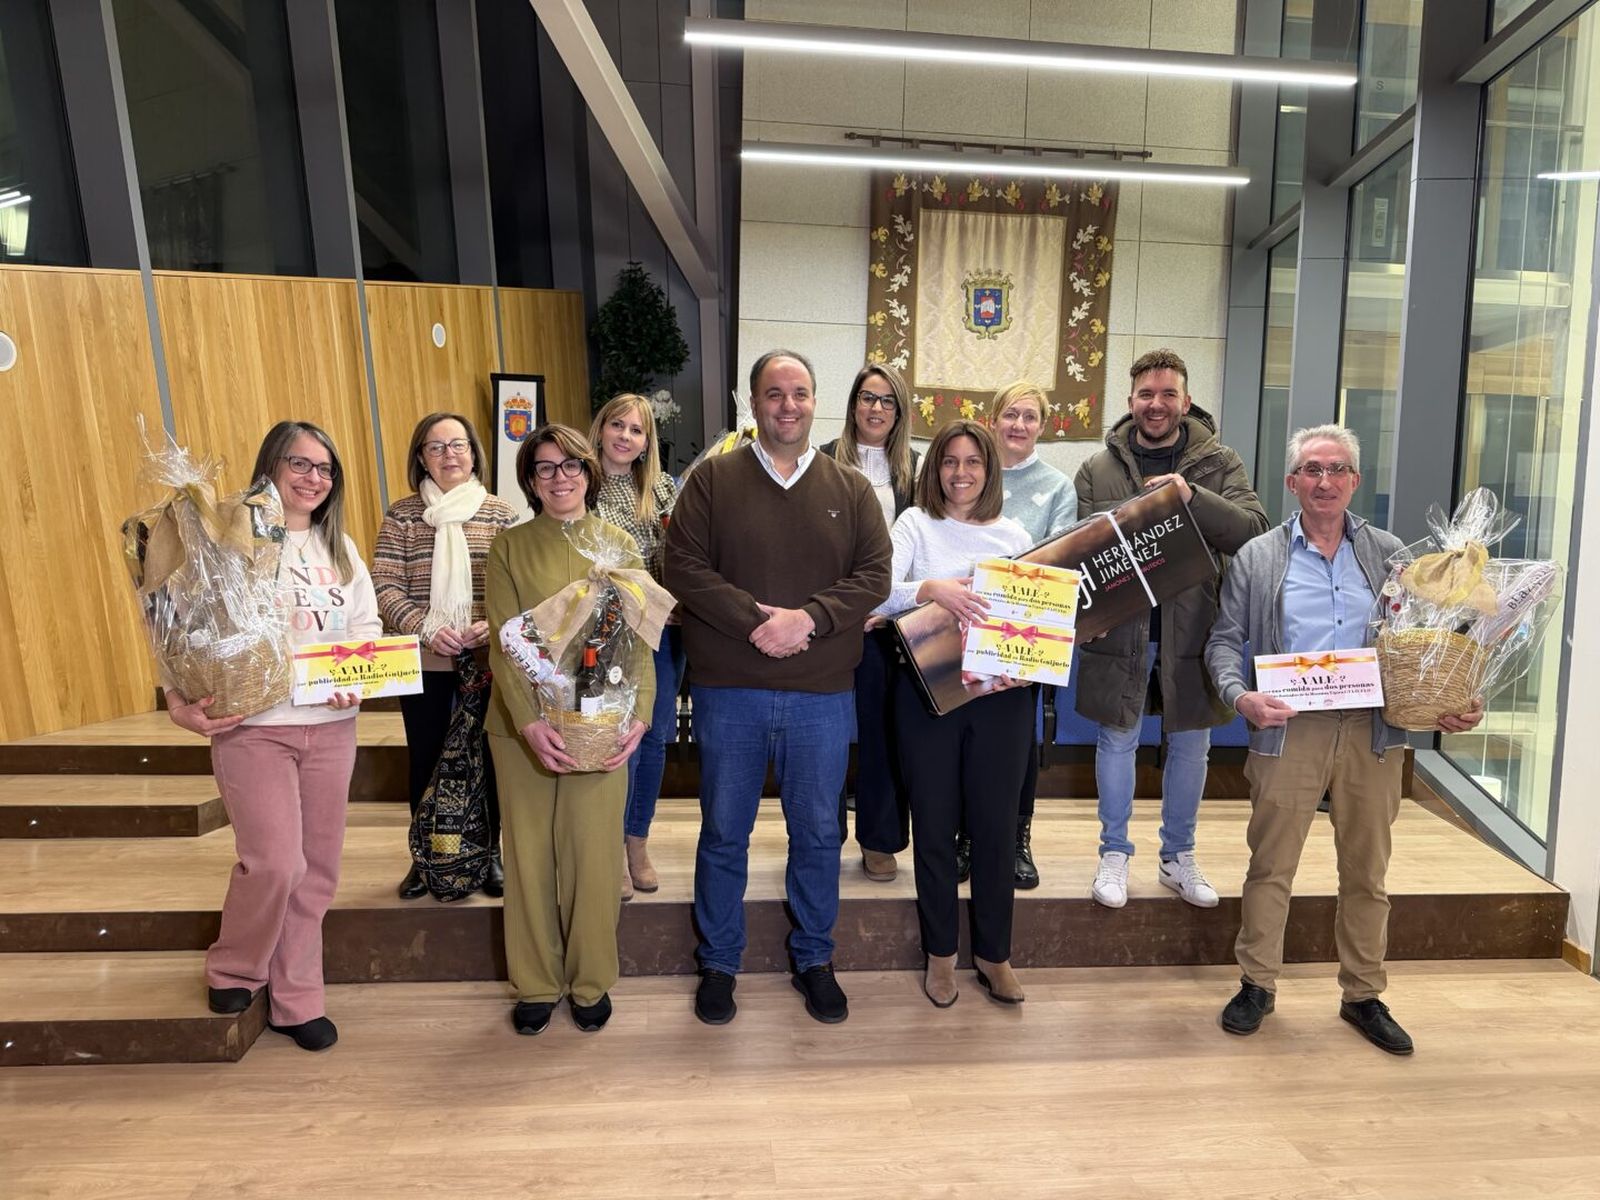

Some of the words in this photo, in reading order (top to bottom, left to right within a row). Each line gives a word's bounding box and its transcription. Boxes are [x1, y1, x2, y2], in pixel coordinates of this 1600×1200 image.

[1092, 514, 1184, 568] HERNÁNDEZ
[1099, 543, 1162, 584] JIMÉNEZ
[288, 566, 337, 586] ND
[293, 587, 345, 607] ESS
[1028, 597, 1041, 605] dos
[1041, 599, 1071, 610] personas
[291, 609, 345, 632] OVE
[976, 649, 1012, 660] publicidad
[1019, 655, 1040, 664] Radio
[308, 676, 351, 687] publicidad
[360, 673, 384, 681] Radio
[1339, 682, 1375, 690] personas
